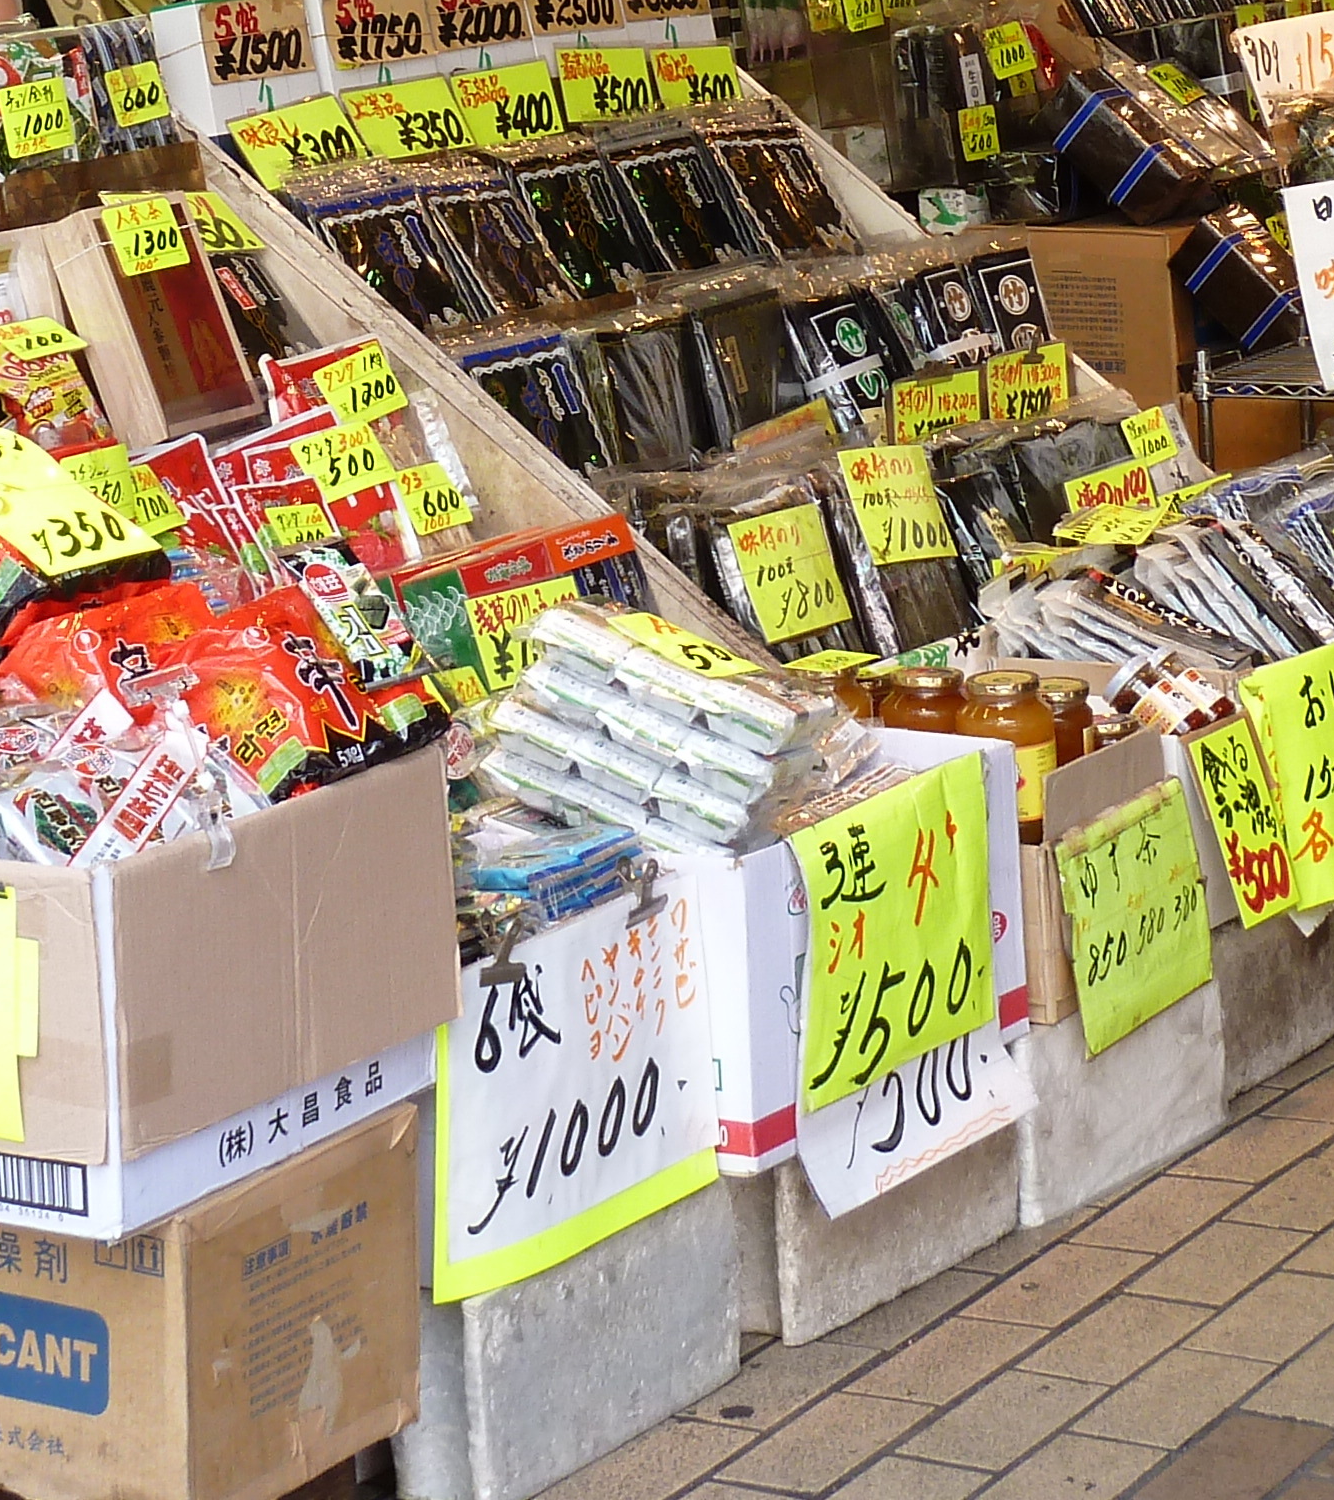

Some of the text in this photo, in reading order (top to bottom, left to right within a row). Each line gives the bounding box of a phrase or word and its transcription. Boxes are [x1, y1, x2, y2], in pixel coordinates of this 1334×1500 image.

[215, 2, 259, 45] 5帖
[850, 457, 915, 485] 味付のり
[32, 509, 125, 564] ¥350
[738, 525, 802, 556] 味付のり
[882, 517, 948, 556] ¥1000
[307, 573, 345, 596] 해표
[776, 577, 835, 629] ¥800
[341, 605, 385, 657] 김
[282, 630, 359, 729] 辛
[234, 707, 289, 765] 라면
[1201, 736, 1249, 790] 食べる
[822, 824, 887, 908] 3連
[1225, 831, 1290, 913] ¥500
[670, 898, 696, 1009] ワサビ
[1088, 931, 1126, 986] 850
[1138, 906, 1163, 955] 580
[474, 964, 562, 1073] 6袋
[219, 1060, 383, 1169] (株)大昌食品
